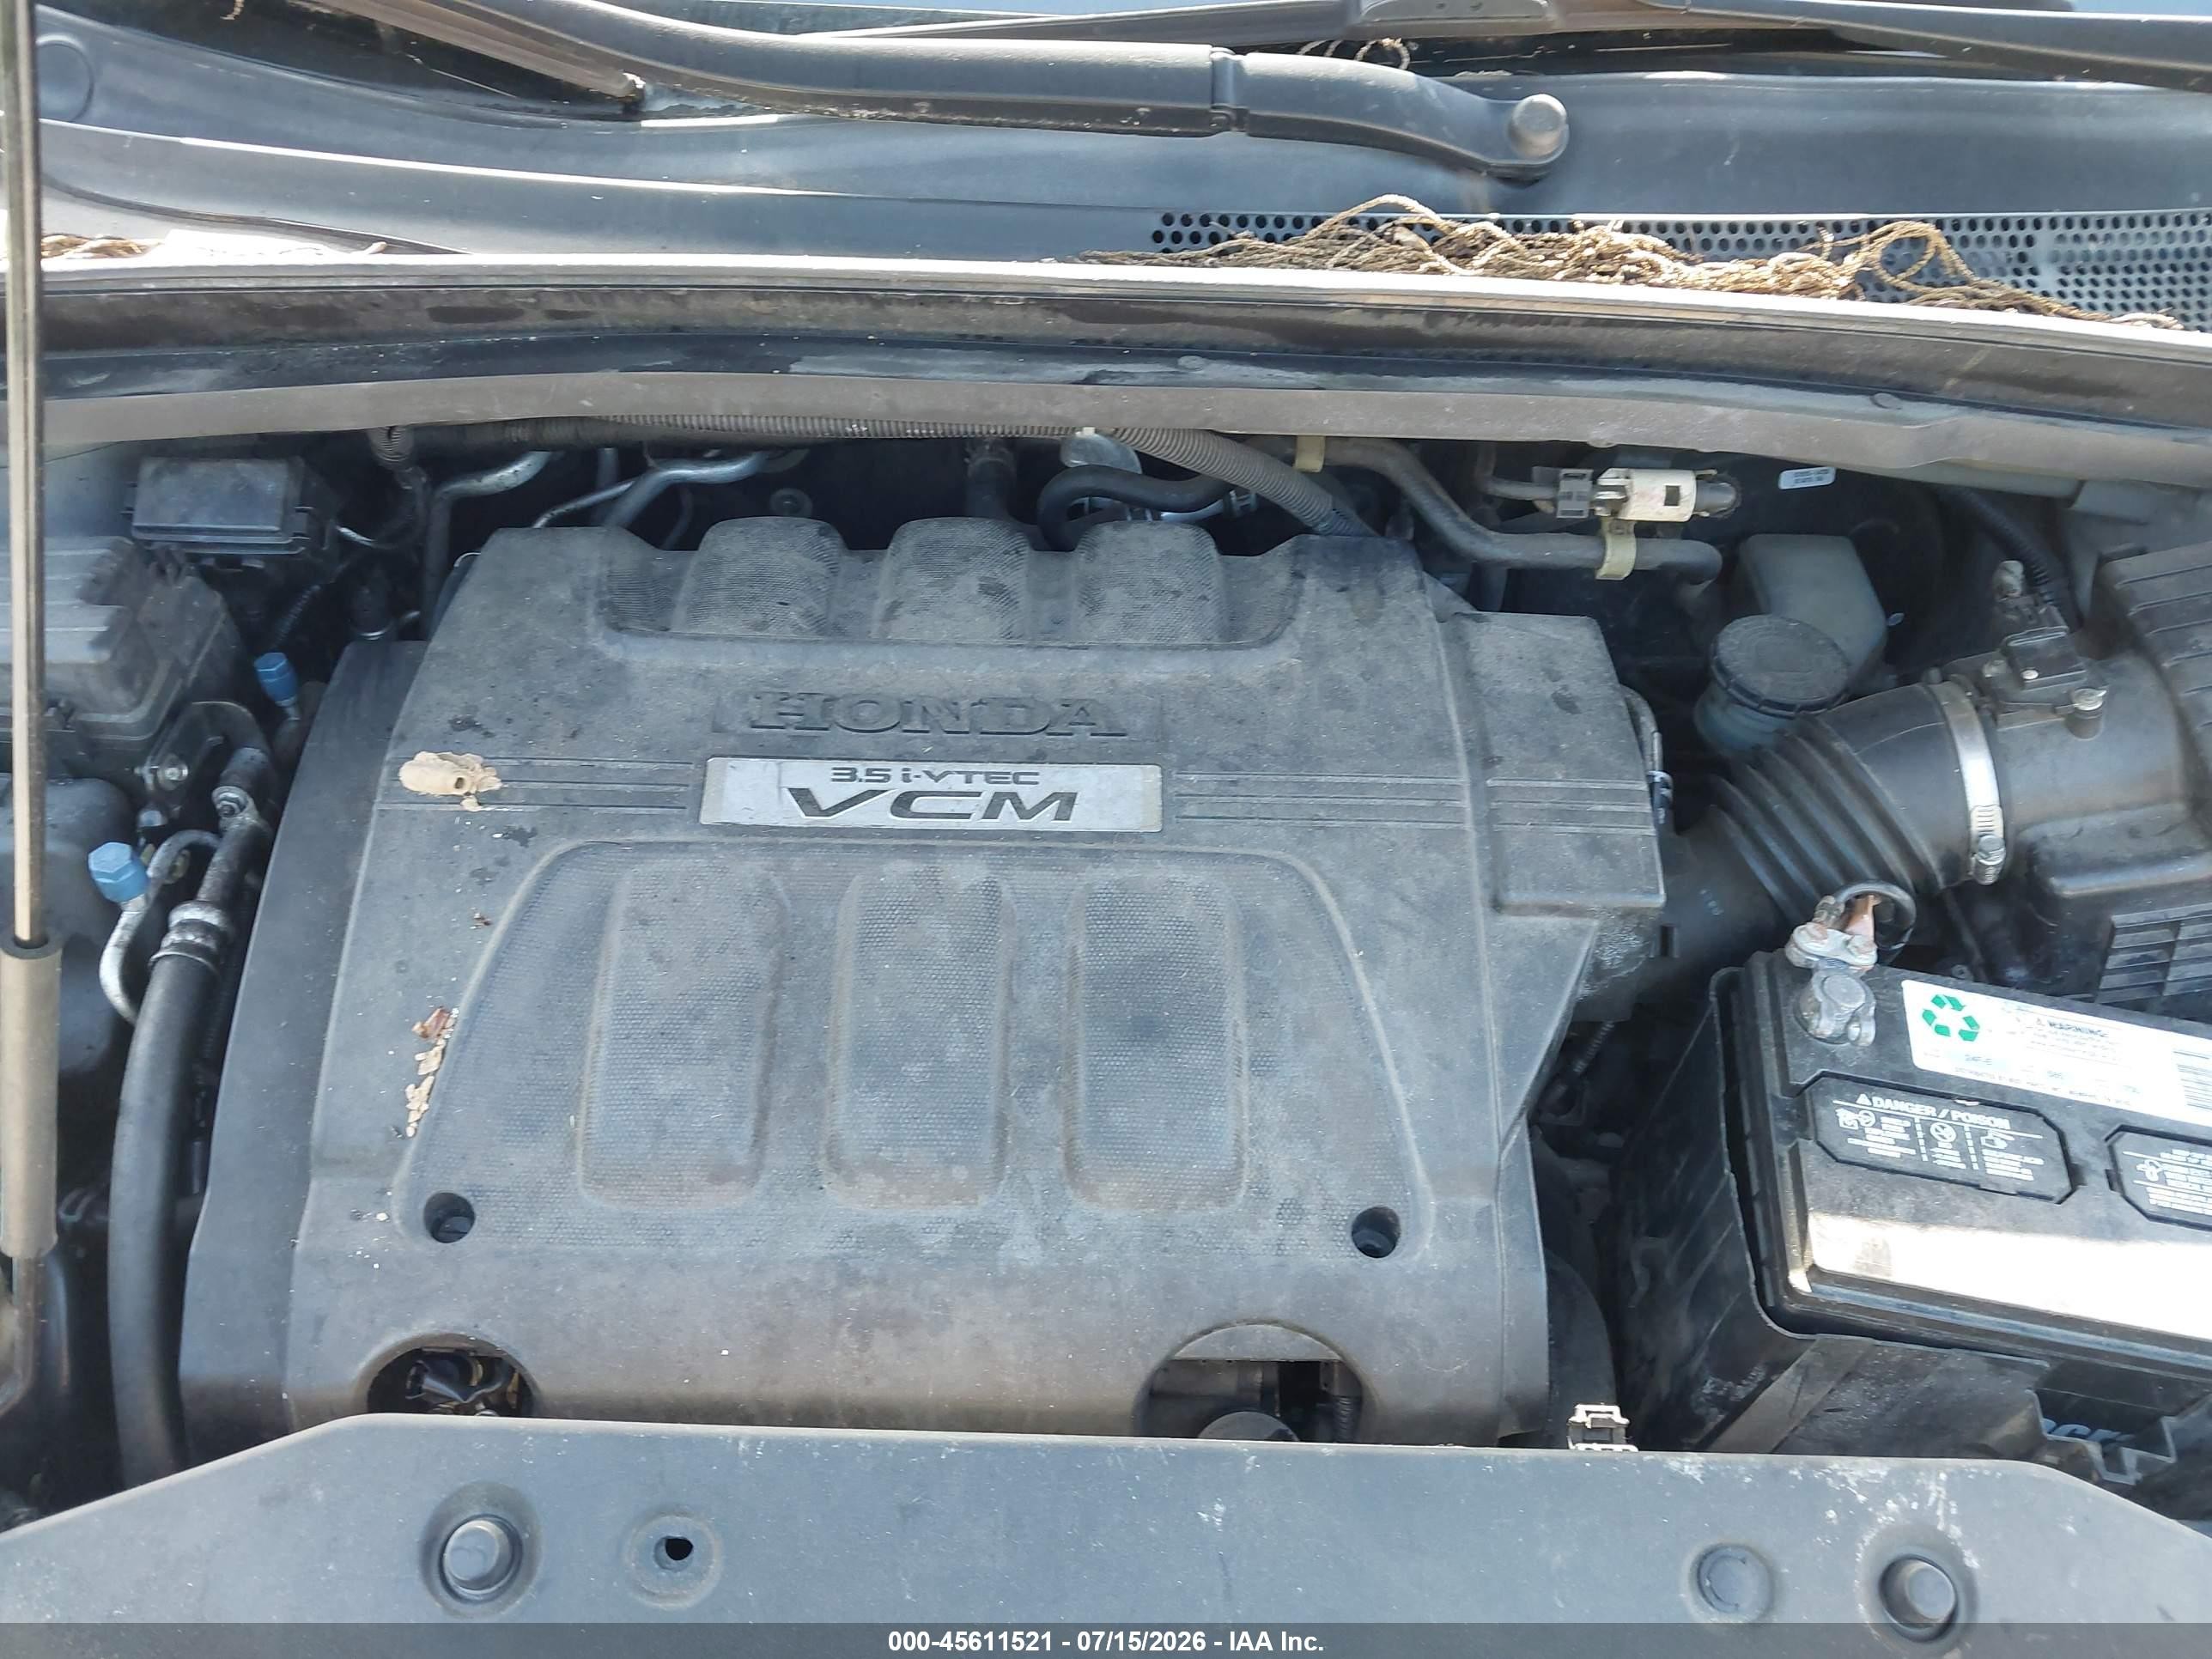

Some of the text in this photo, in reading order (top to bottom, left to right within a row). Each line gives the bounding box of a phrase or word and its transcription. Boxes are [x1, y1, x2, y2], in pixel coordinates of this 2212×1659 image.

[750, 692, 1127, 737] HONDA
[830, 767, 1040, 785] 3.5 i-VTEC
[787, 787, 1078, 822] VCM
[1872, 1096, 1937, 1118] DANGER
[1951, 1110, 2011, 1130] POISON
